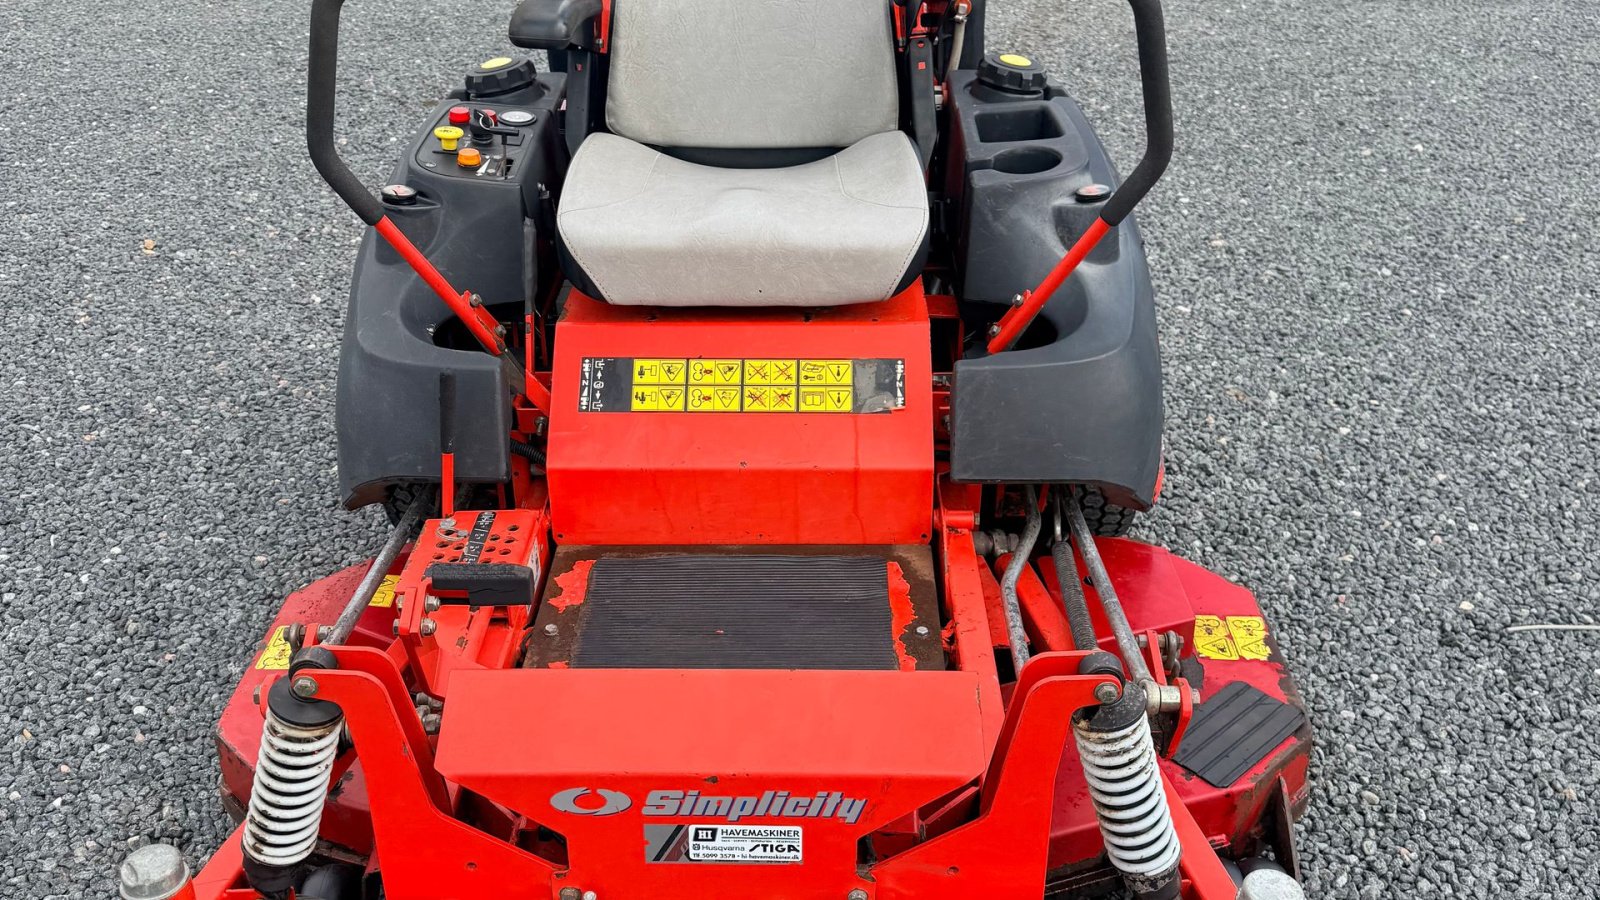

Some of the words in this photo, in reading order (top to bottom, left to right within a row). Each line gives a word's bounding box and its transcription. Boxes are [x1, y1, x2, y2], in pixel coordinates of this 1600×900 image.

[642, 789, 868, 824] Simplicity
[698, 830, 713, 840] HI
[721, 829, 800, 837] HAVEMASKINER
[702, 844, 745, 852] Husqvarna
[749, 844, 800, 853] STIGA
